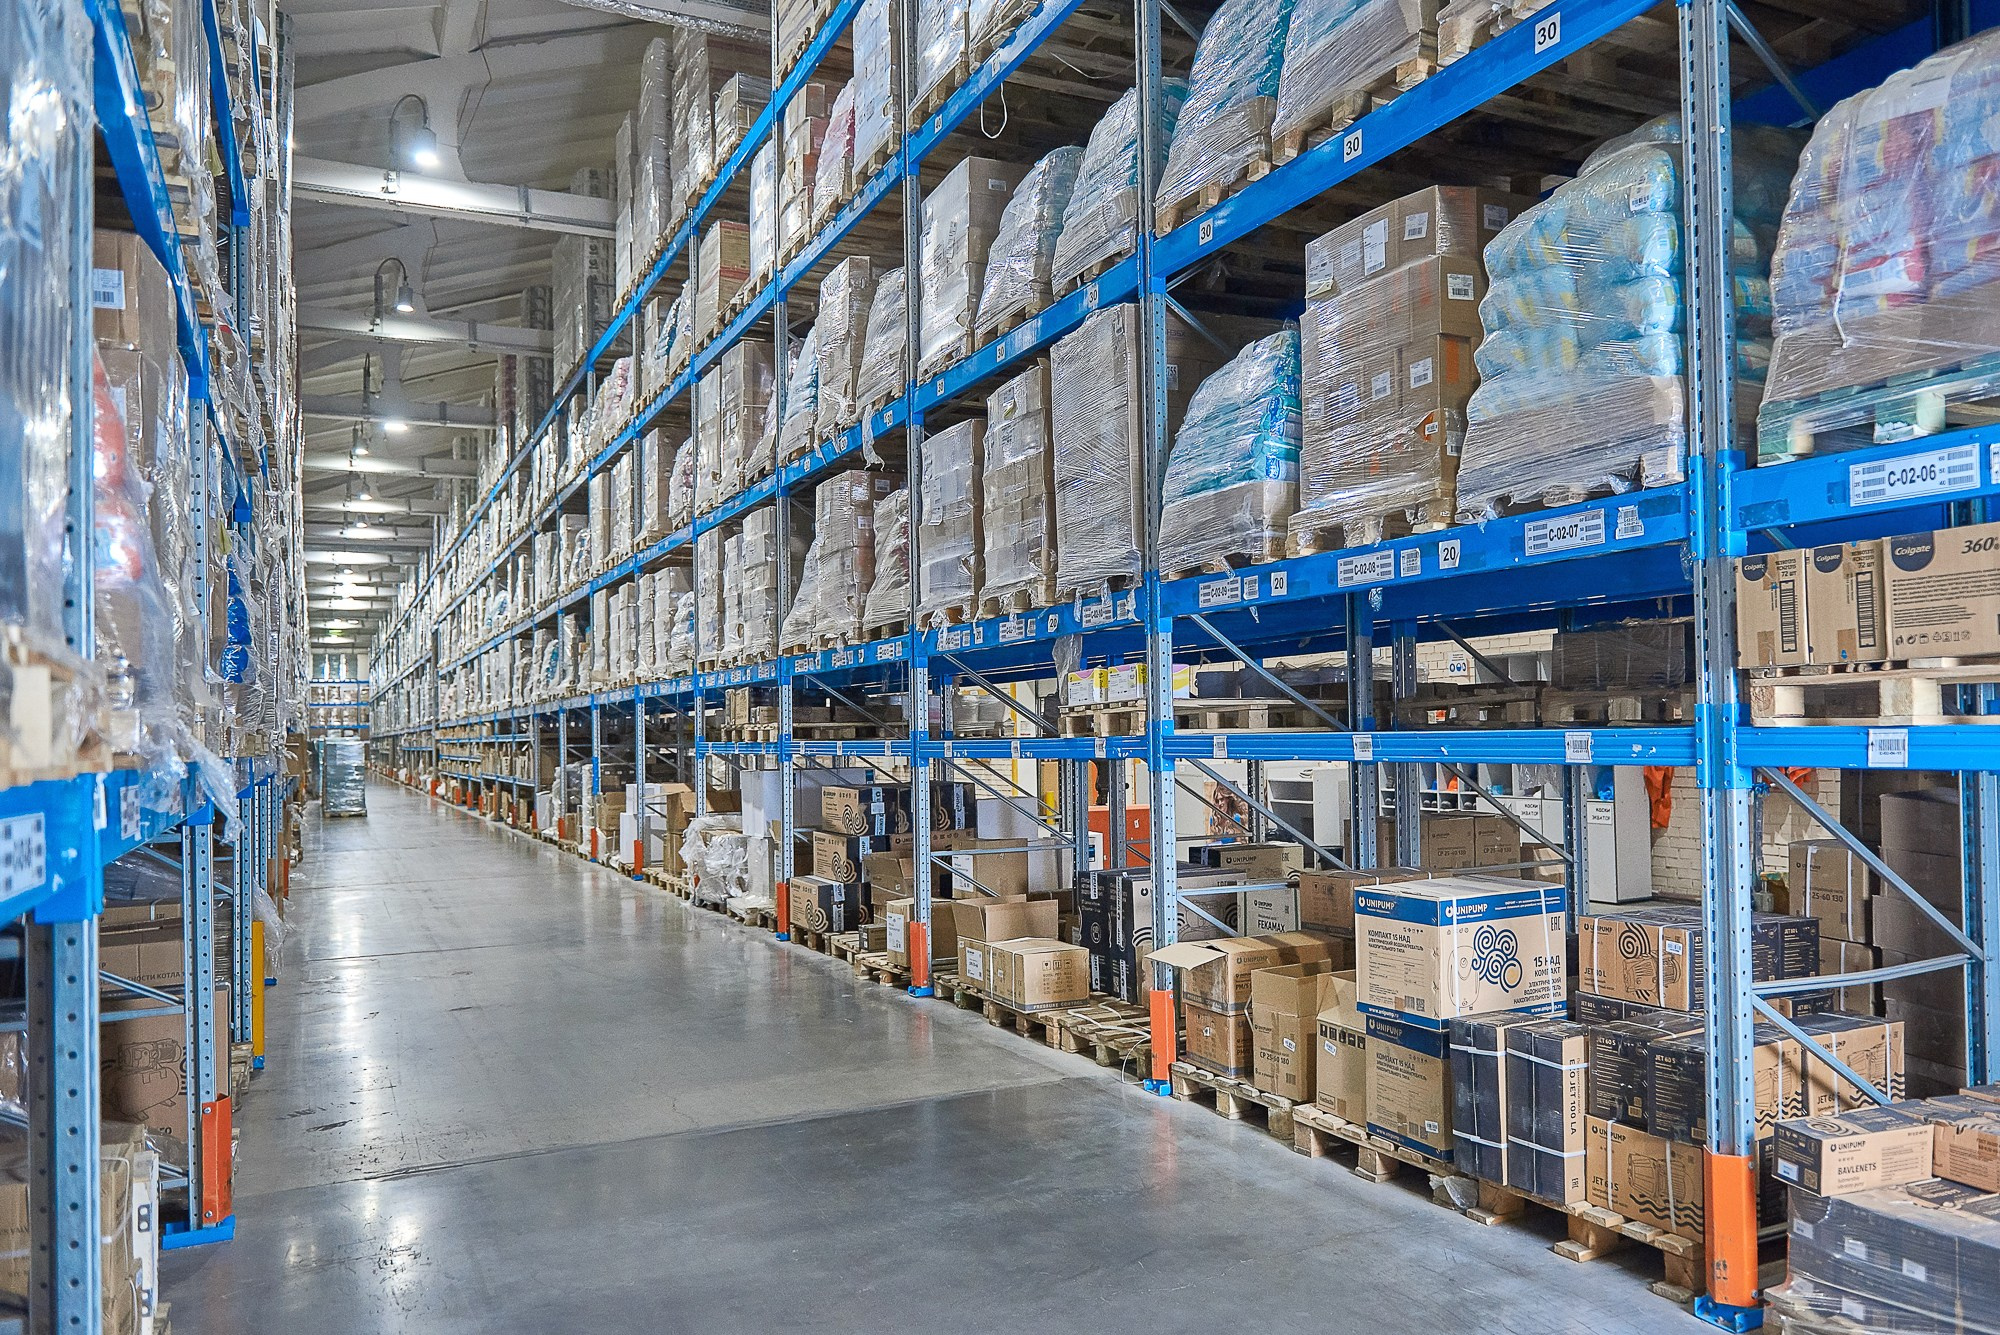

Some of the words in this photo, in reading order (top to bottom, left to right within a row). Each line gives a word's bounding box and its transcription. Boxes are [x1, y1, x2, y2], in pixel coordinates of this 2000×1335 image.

[1537, 22, 1557, 46] 30
[1346, 136, 1360, 156] 30
[1200, 224, 1212, 241] 30
[1089, 290, 1098, 304] 30
[1888, 464, 1937, 487] C-02-06
[1549, 524, 1579, 541] C-02-07
[1442, 546, 1456, 562] 20
[1895, 545, 1931, 556] Colgate
[1816, 553, 1840, 562] Colgate
[1744, 563, 1765, 571] Colgate
[1275, 578, 1284, 590] 20
[1050, 618, 1057, 628] 20
[1812, 892, 1831, 901] 25-60
[1366, 899, 1395, 910] UNIPUMP
[1456, 904, 1488, 915] UNIPUMP
[1258, 920, 1285, 933] FEKAMAX
[1551, 916, 1561, 932] EAC
[1368, 930, 1392, 940] КОМПАКТ
[1392, 932, 1398, 940] 15
[1398, 934, 1411, 944] НАД
[1533, 956, 1543, 967] 15
[157, 972, 181, 980] КОТЛА
[1584, 967, 1594, 975] JET
[1376, 1022, 1402, 1036] UNIPUMP
[1260, 1051, 1267, 1059] CP
[1376, 1052, 1398, 1065] КОМПАКТ
[1817, 1095, 1827, 1105] JET
[1571, 1122, 1577, 1135] LA
[1599, 1128, 1626, 1142] UNPUMP
[1838, 1140, 1866, 1151] UNIPUMP
[1838, 1162, 1877, 1175] BAVLENETS
[1592, 1176, 1603, 1186] JET
[1614, 1183, 1619, 1191] S
